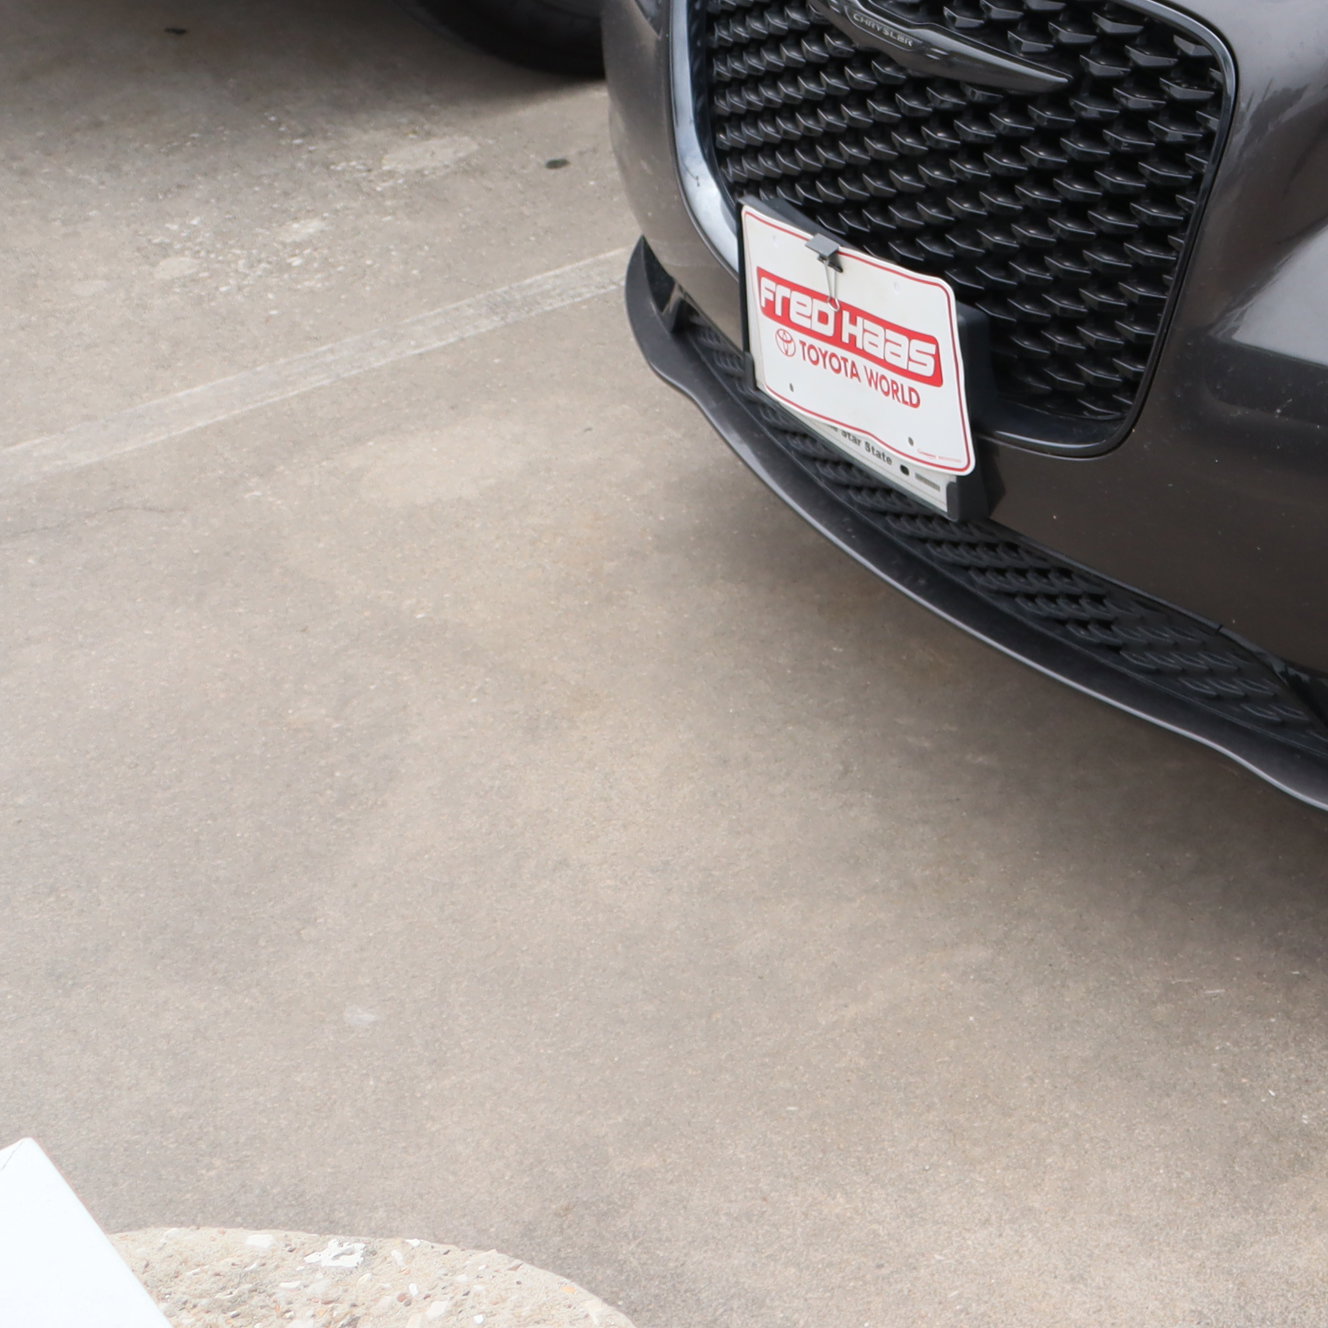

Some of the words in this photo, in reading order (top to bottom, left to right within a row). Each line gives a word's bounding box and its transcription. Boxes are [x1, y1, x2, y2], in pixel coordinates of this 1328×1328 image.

[853, 13, 914, 47] CHRYSLER
[799, 339, 862, 383] TOYOTA
[864, 365, 921, 409] WORLD
[864, 441, 893, 465] State
